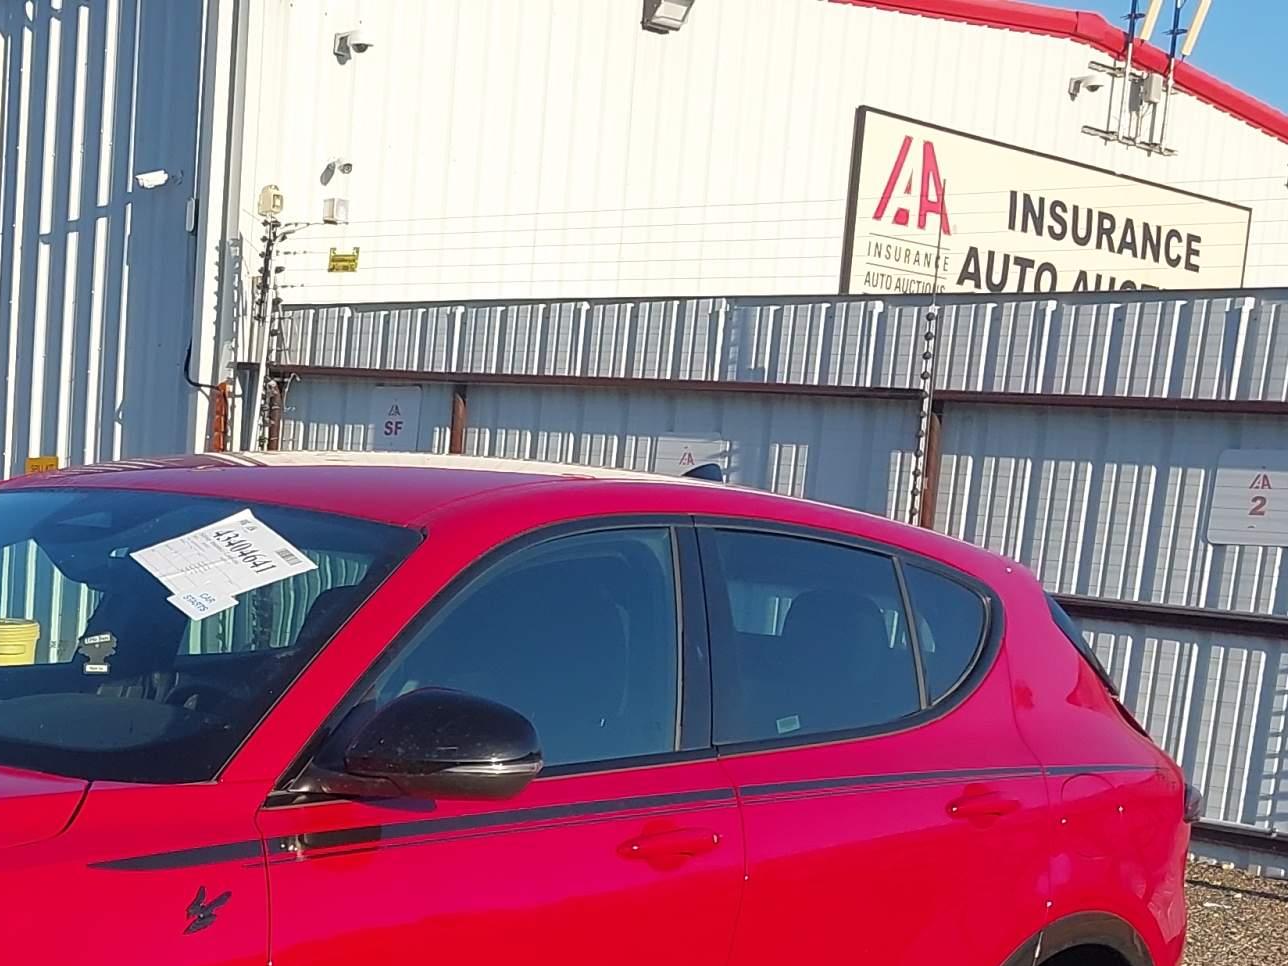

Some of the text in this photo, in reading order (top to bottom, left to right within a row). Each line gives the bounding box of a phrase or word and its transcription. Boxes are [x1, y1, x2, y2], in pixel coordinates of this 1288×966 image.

[1007, 190, 1202, 273] INSURANCE
[864, 271, 893, 290] AUTO
[956, 246, 1059, 292] AUTO
[384, 421, 403, 436] SF
[1248, 496, 1267, 515] 2
[213, 530, 277, 574] 43404641
